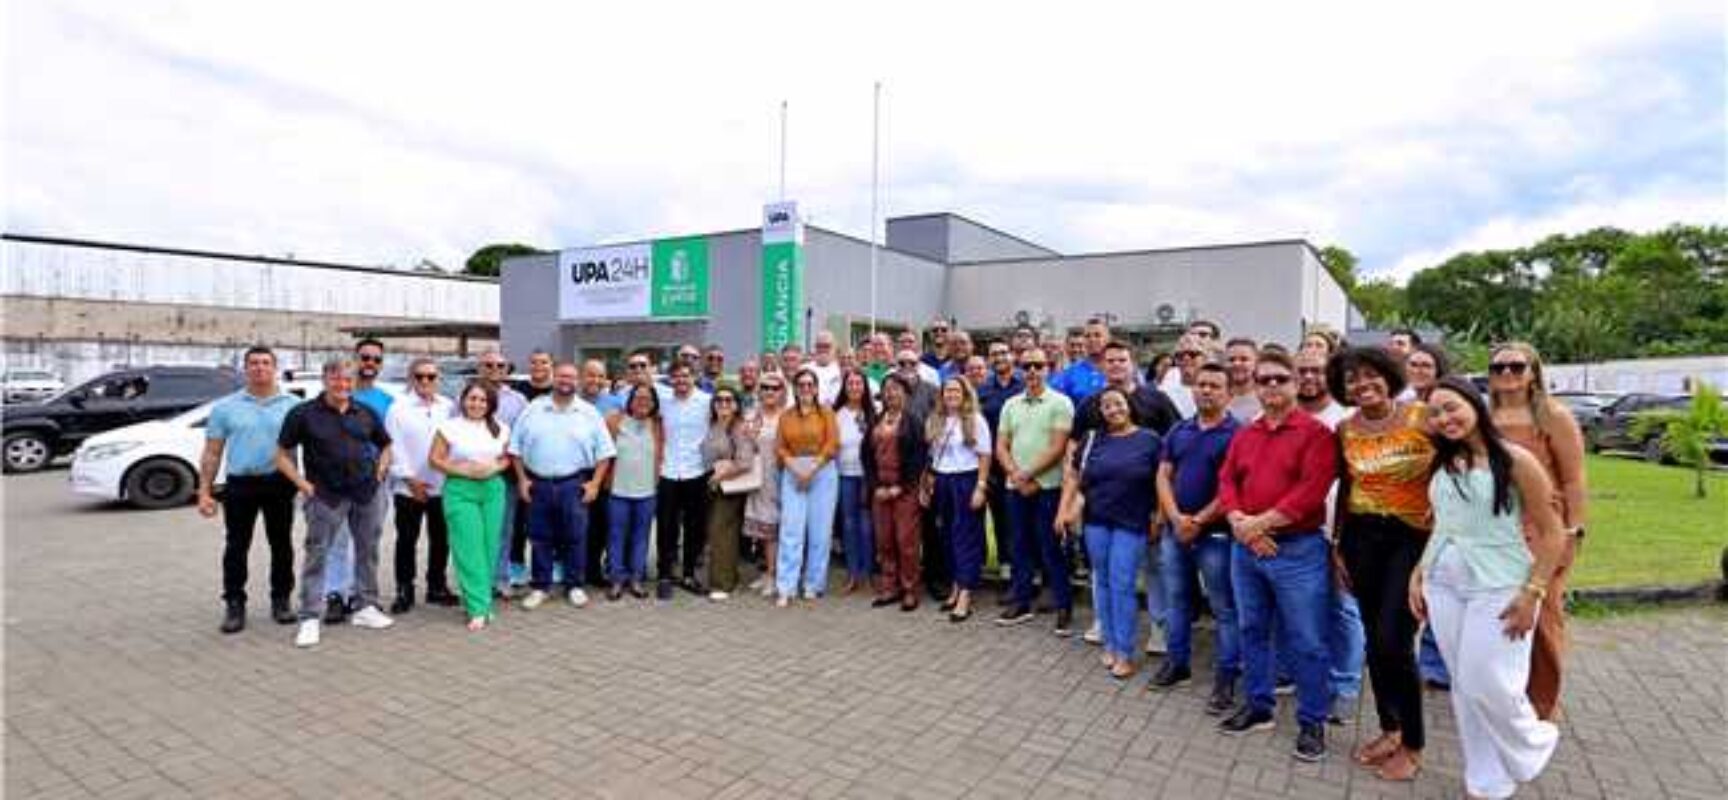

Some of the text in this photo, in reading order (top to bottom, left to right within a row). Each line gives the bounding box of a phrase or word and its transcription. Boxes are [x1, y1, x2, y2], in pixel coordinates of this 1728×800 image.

[768, 211, 790, 224] UPA
[571, 257, 649, 284] UPA 24H
